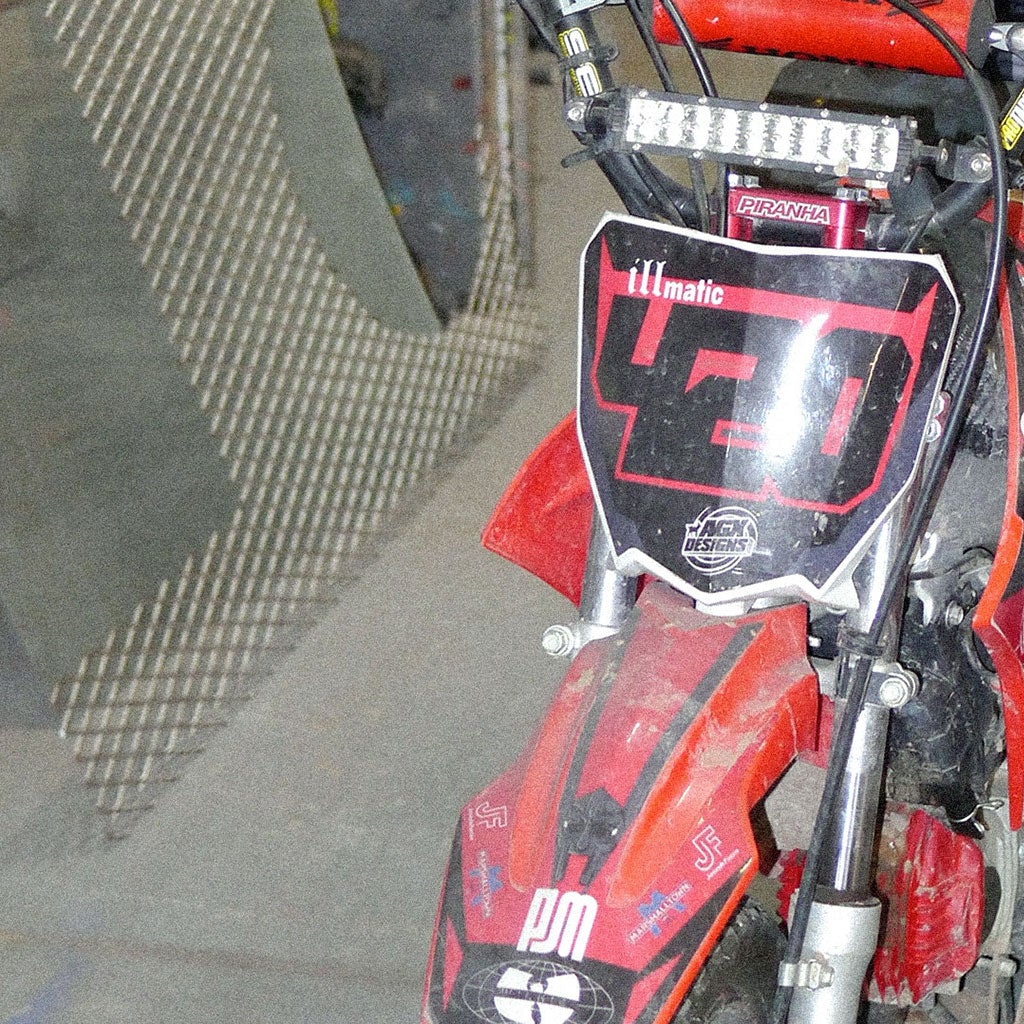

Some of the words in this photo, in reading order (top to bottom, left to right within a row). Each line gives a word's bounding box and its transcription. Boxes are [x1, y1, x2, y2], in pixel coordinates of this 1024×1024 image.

[736, 195, 831, 225] PIRANHA
[628, 258, 725, 305] illmatic
[683, 538, 749, 553] DESIGNS
[626, 880, 692, 945] MARSHALLTOWN
